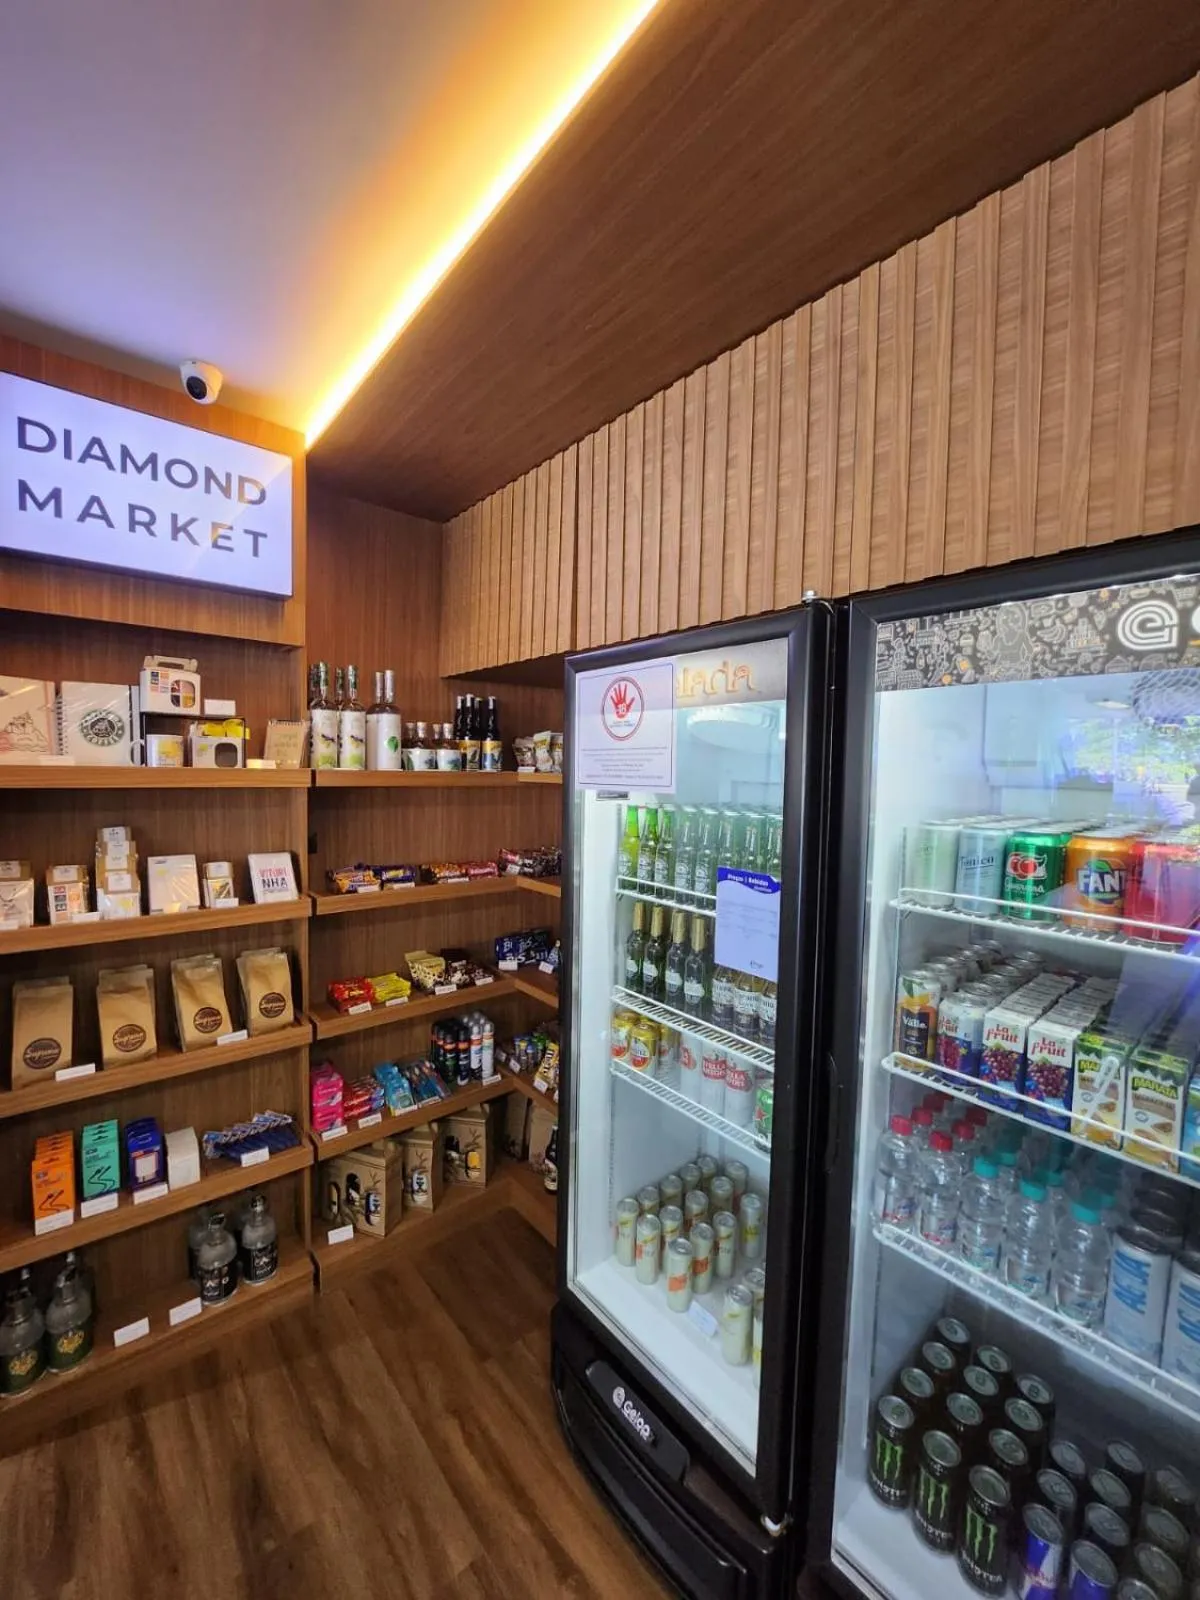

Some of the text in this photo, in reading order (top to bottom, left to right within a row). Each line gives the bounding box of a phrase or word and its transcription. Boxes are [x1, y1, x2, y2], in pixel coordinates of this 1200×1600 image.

[16, 415, 268, 506] DIAMOND
[18, 478, 269, 558] MARKET
[996, 1023, 1010, 1034] La
[1042, 1036, 1057, 1048] La
